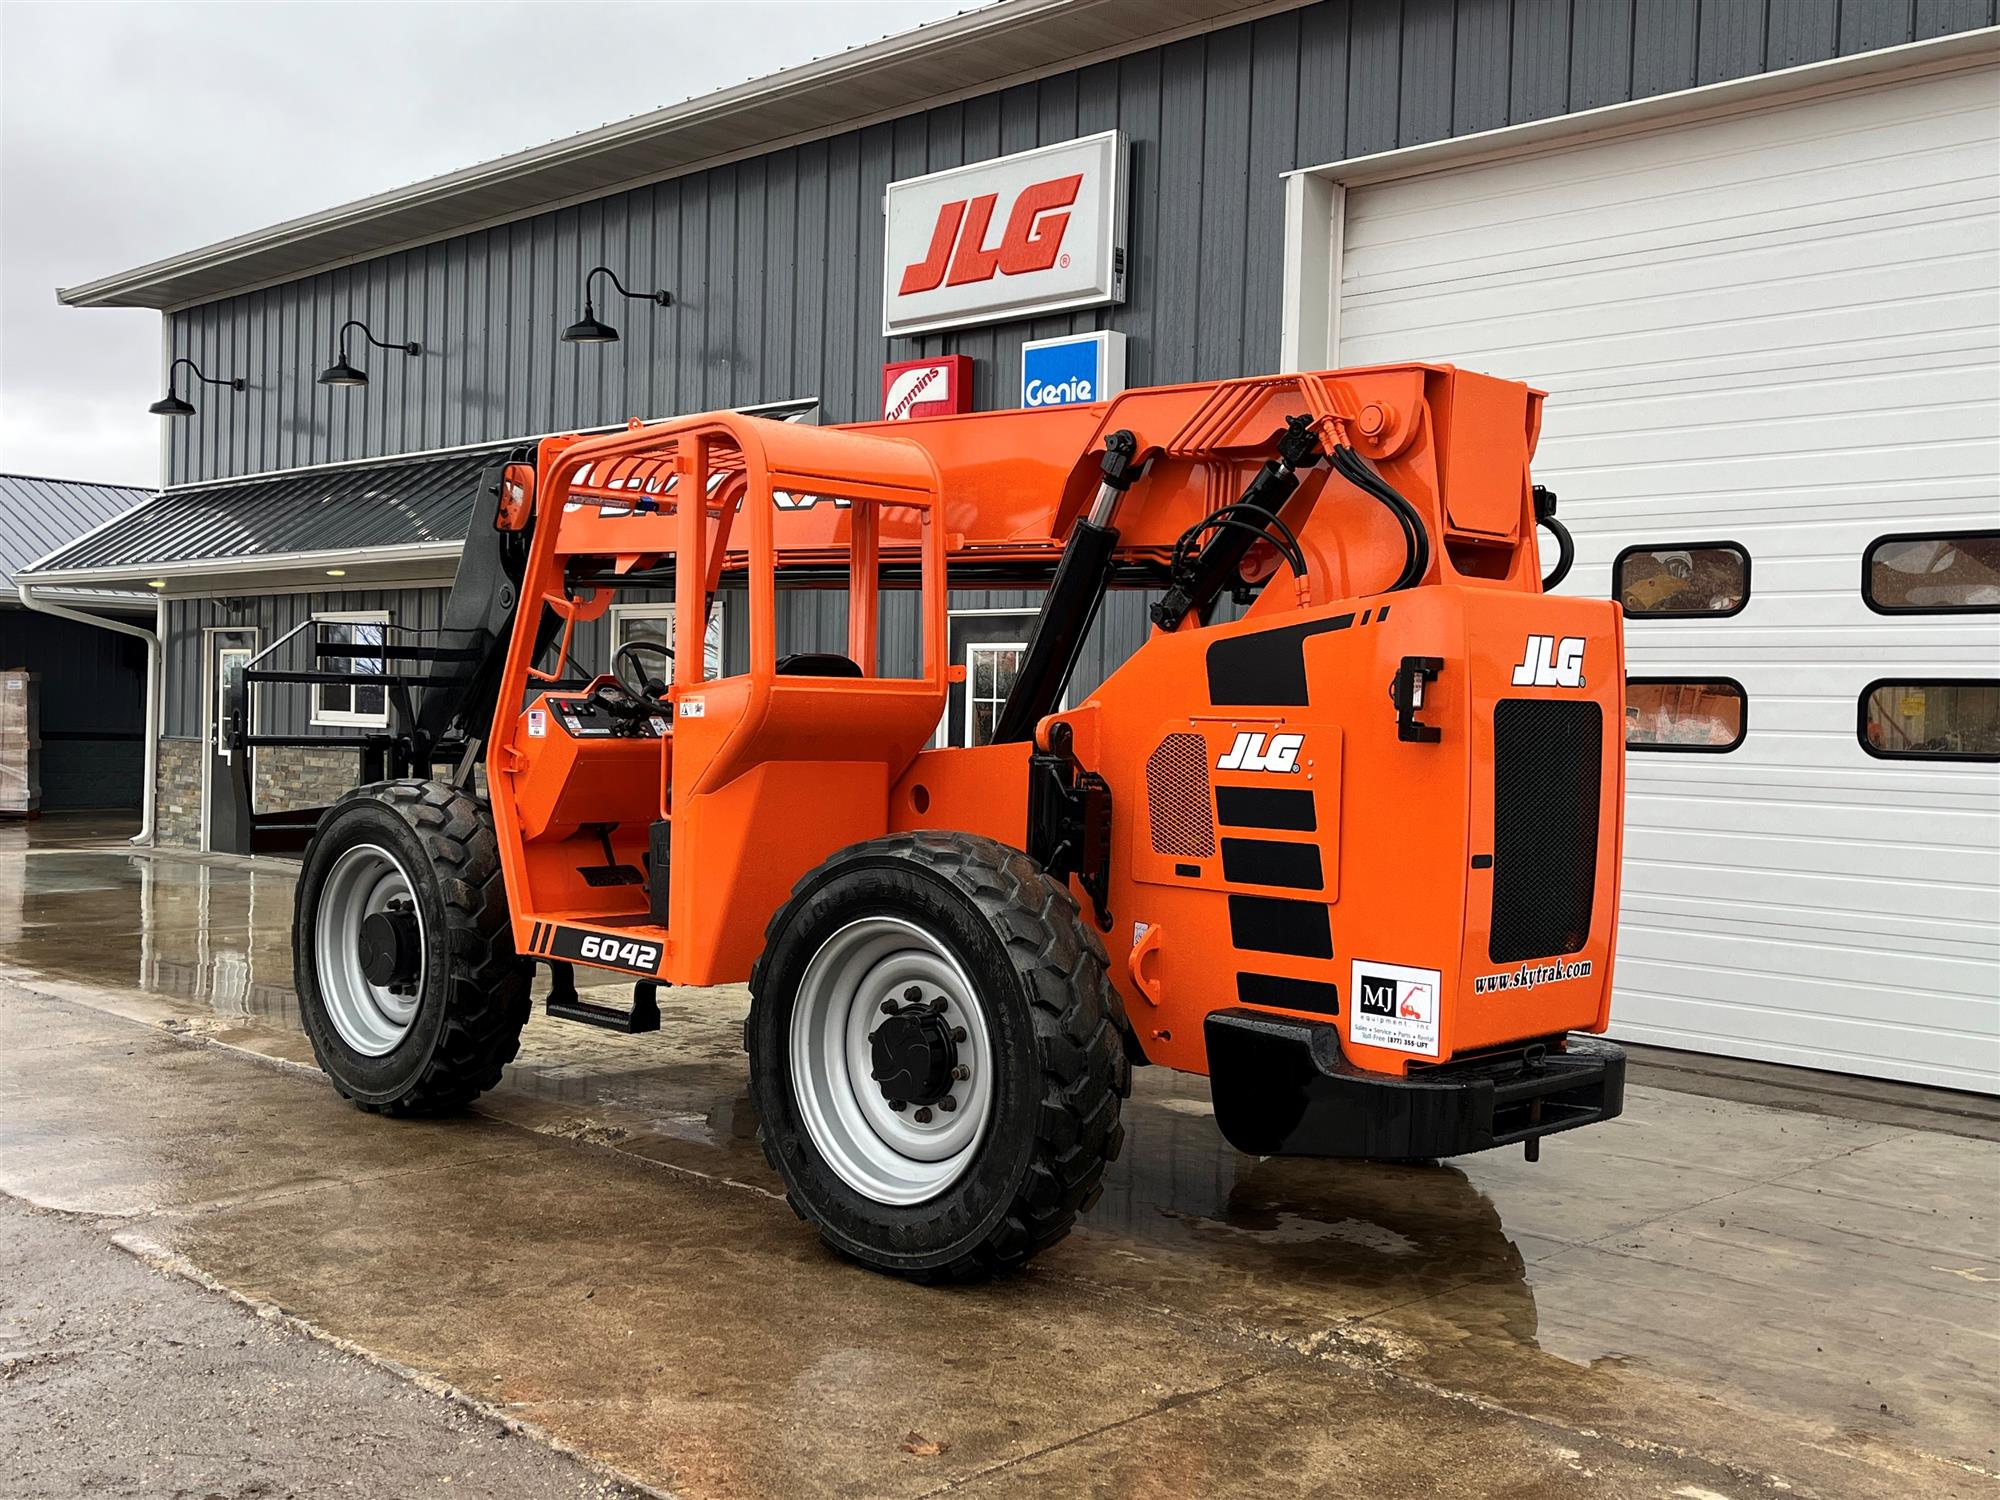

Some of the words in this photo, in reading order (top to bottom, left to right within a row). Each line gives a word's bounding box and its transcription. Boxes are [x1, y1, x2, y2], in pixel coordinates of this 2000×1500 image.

[898, 173, 1084, 296] JLG
[1026, 376, 1091, 406] Genie
[1511, 634, 1585, 687] JLG
[1216, 732, 1305, 773] JLG
[580, 935, 657, 969] 6042
[1475, 958, 1592, 994] www.skytrak.com
[1363, 984, 1393, 1012] MJ
[1374, 1027, 1392, 1035] Service
